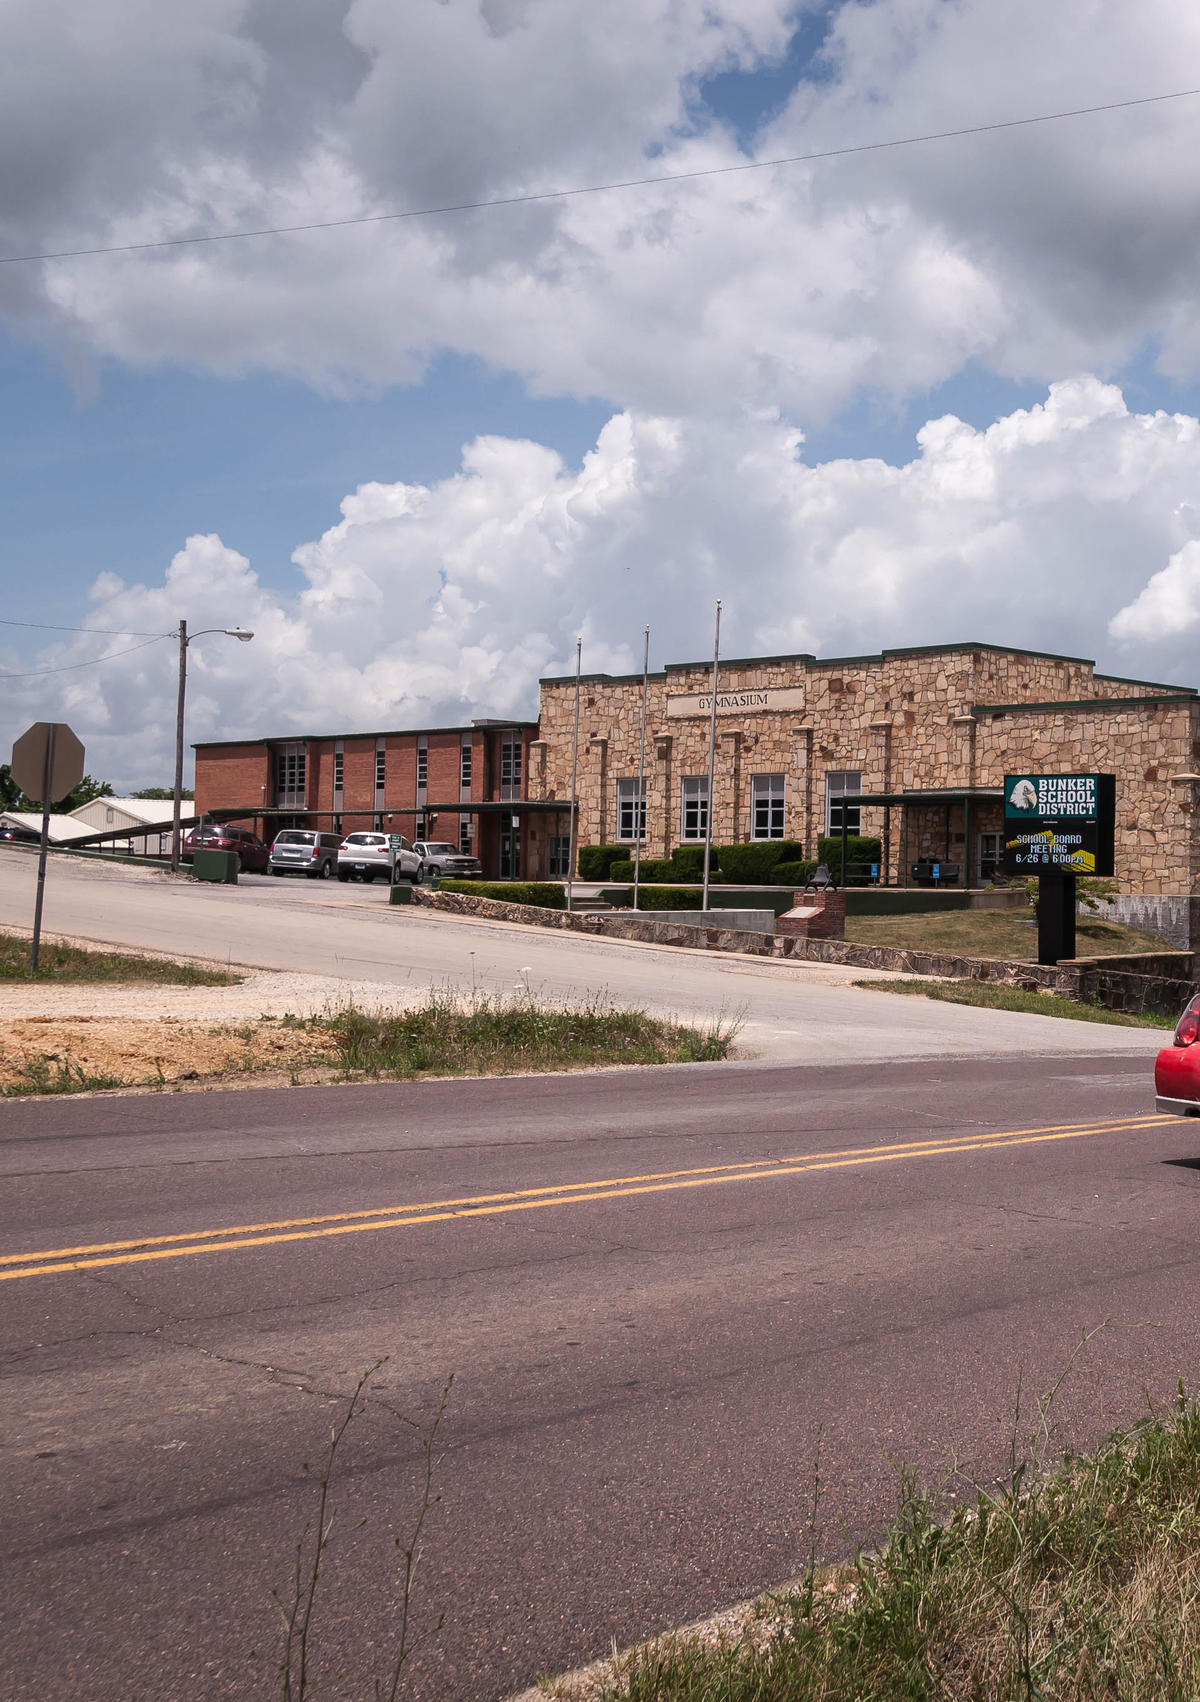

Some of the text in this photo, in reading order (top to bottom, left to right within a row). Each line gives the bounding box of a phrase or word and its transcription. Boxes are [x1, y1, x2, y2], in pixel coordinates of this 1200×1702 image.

[698, 694, 768, 708] GYMNASIUM
[1038, 778, 1095, 791] BUNKER
[1038, 790, 1095, 803] SCHOOL
[1038, 802, 1095, 815] DISTRICT
[1016, 834, 1082, 844] SCHOOL BOARD
[1030, 844, 1068, 854] MEETING
[1015, 854, 1039, 863] 6/26
